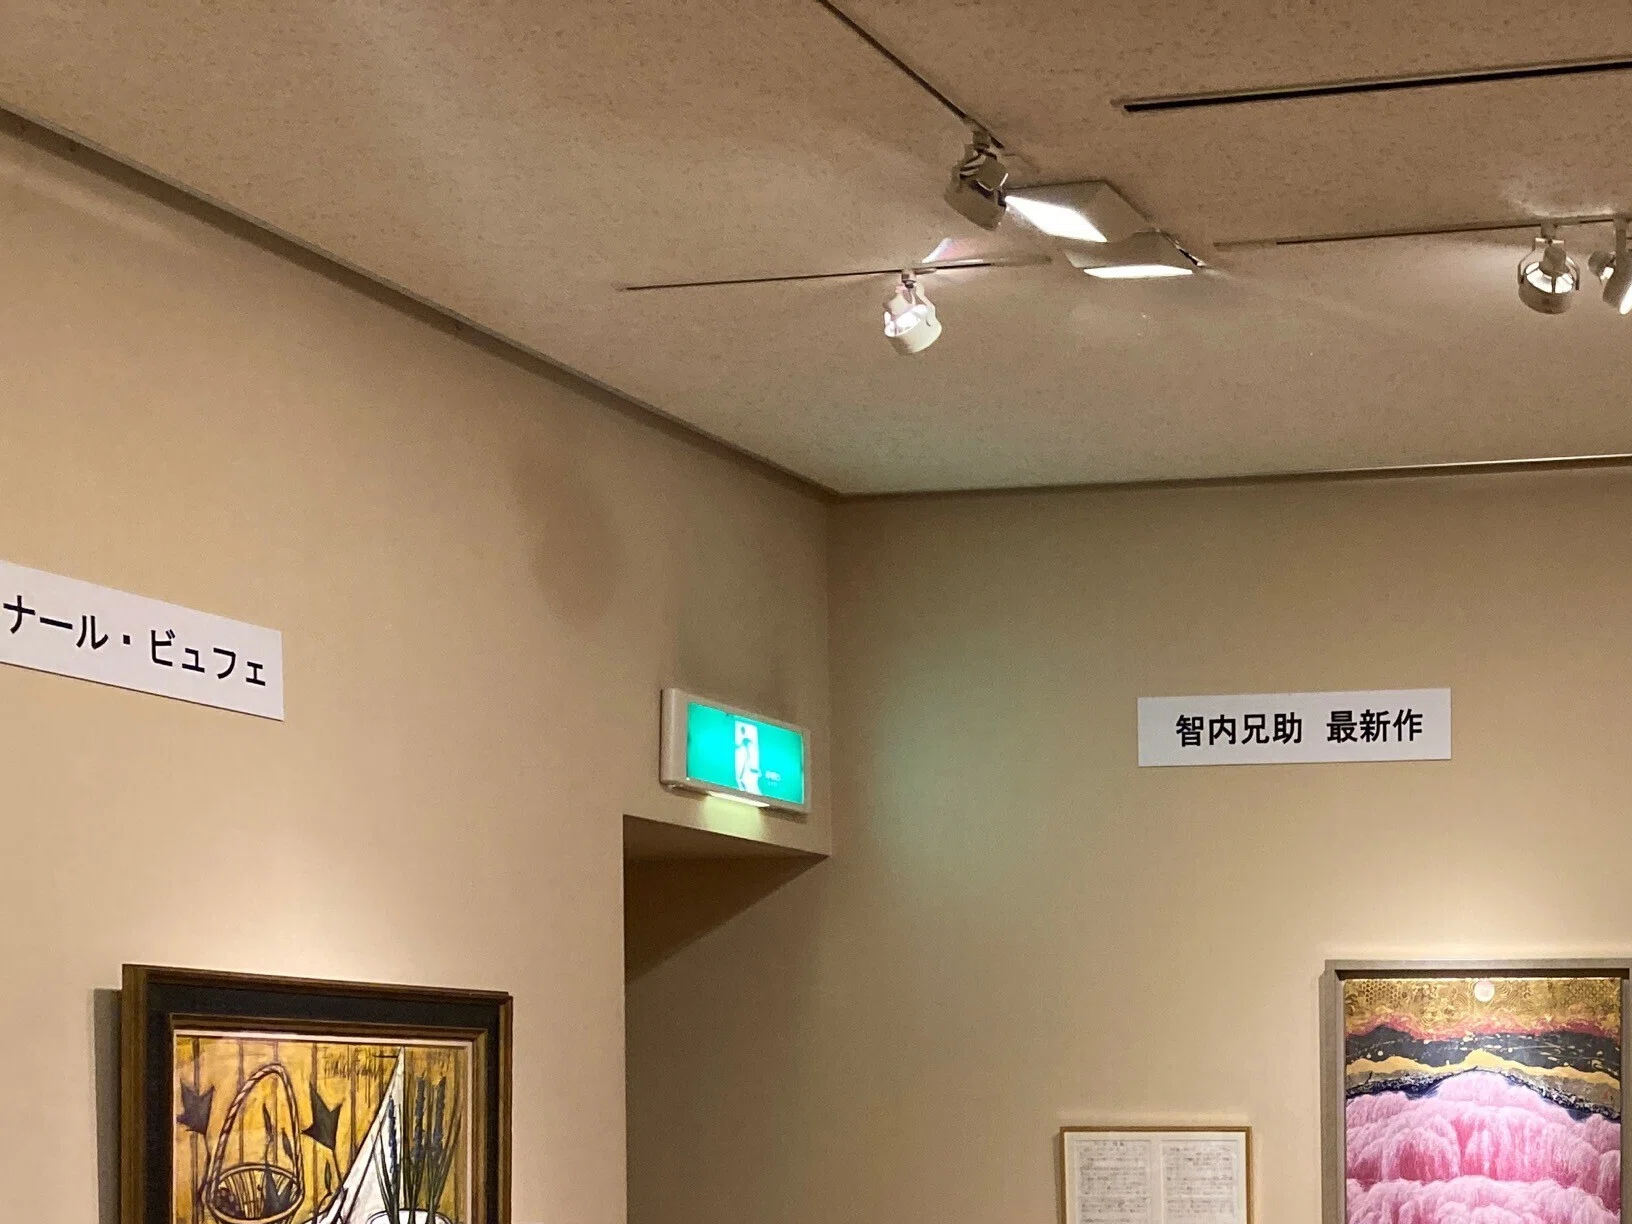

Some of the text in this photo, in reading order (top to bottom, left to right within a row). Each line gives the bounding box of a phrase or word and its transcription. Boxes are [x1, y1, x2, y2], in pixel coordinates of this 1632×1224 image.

[2, 594, 266, 687] ナール・ビュフェ
[1176, 708, 1424, 747] 智内兄助 最新作
